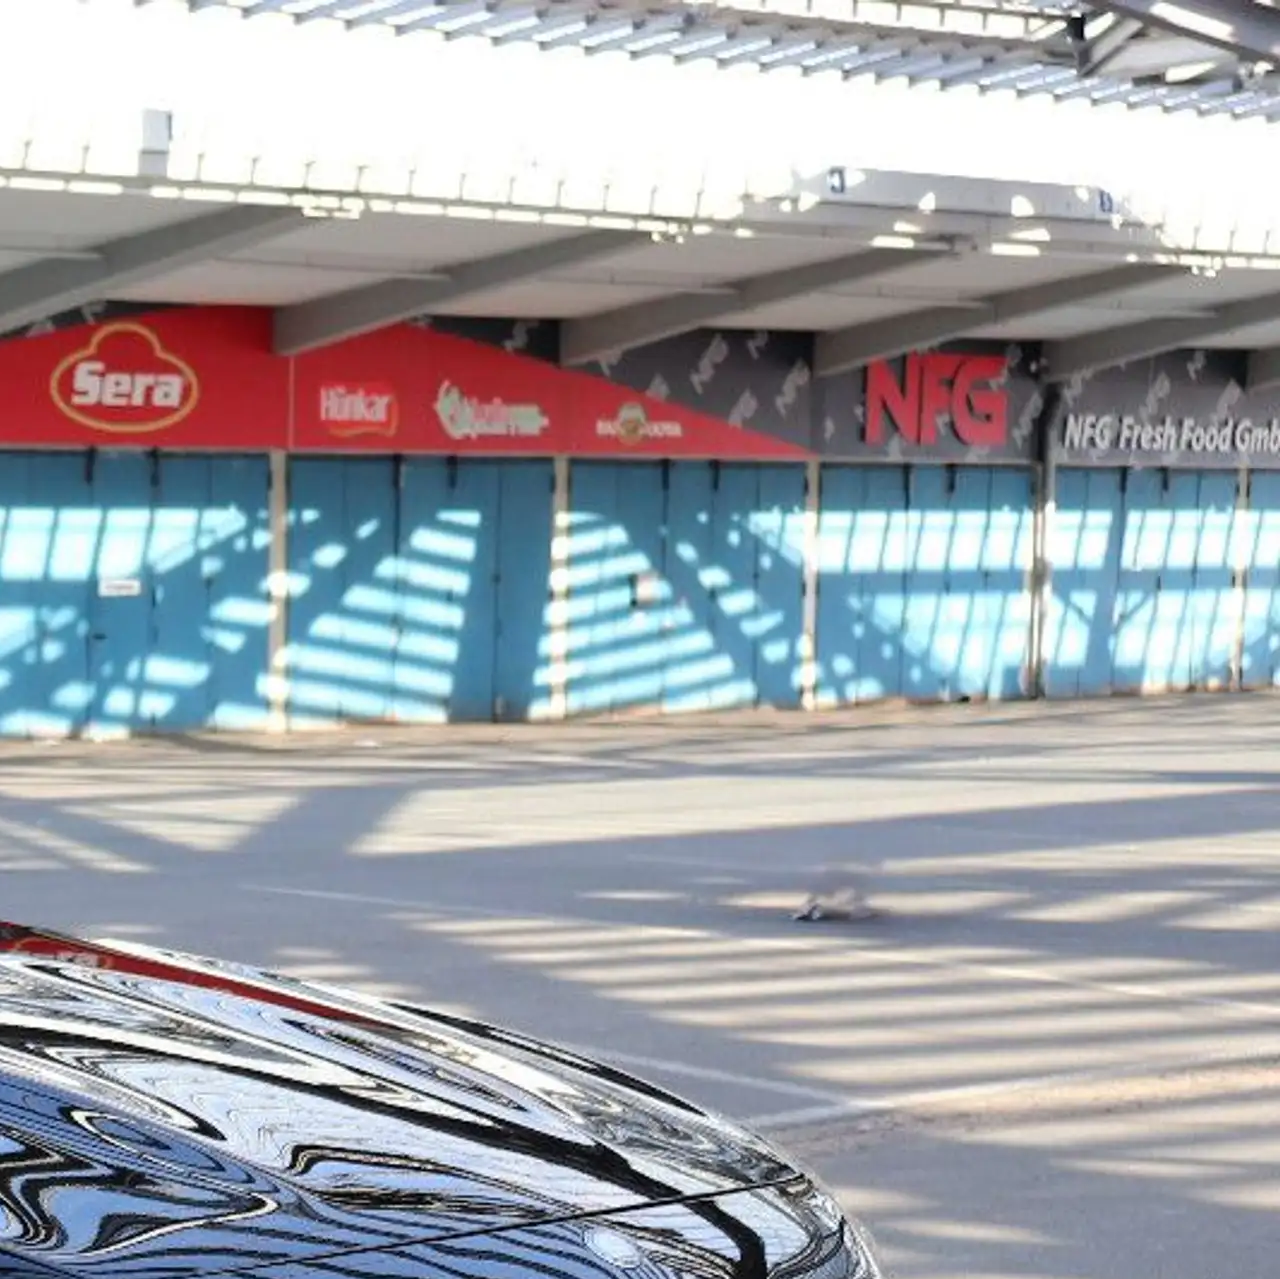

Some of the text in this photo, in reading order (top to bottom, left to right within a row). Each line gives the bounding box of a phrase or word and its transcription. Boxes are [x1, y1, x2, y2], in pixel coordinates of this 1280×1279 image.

[71, 361, 182, 407] Sera
[865, 350, 1008, 446] NFG
[1064, 413, 1280, 453] NFG Fresh Food Gmb
